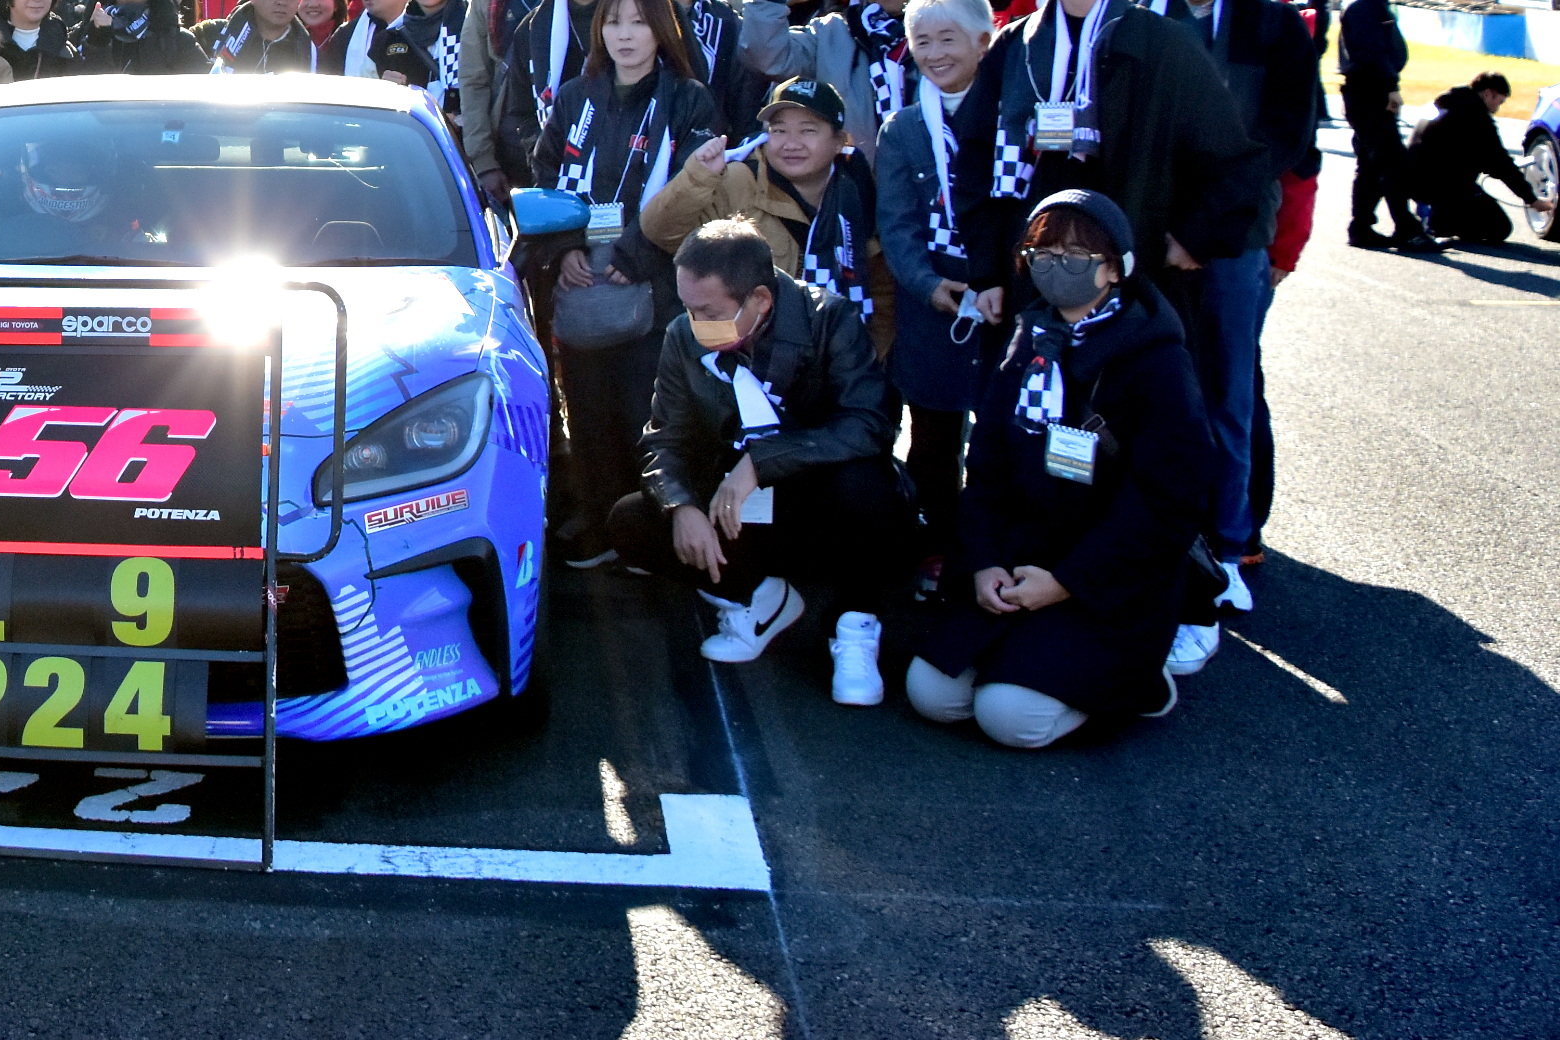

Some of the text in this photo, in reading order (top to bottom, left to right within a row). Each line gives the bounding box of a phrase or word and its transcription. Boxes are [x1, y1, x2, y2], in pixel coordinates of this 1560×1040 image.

[577, 104, 596, 150] FACTORY
[11, 321, 39, 329] TOYOTA
[61, 313, 152, 338] sparco
[133, 507, 221, 522] POTENZA
[110, 556, 176, 647] 9
[364, 676, 483, 726] POTENZA
